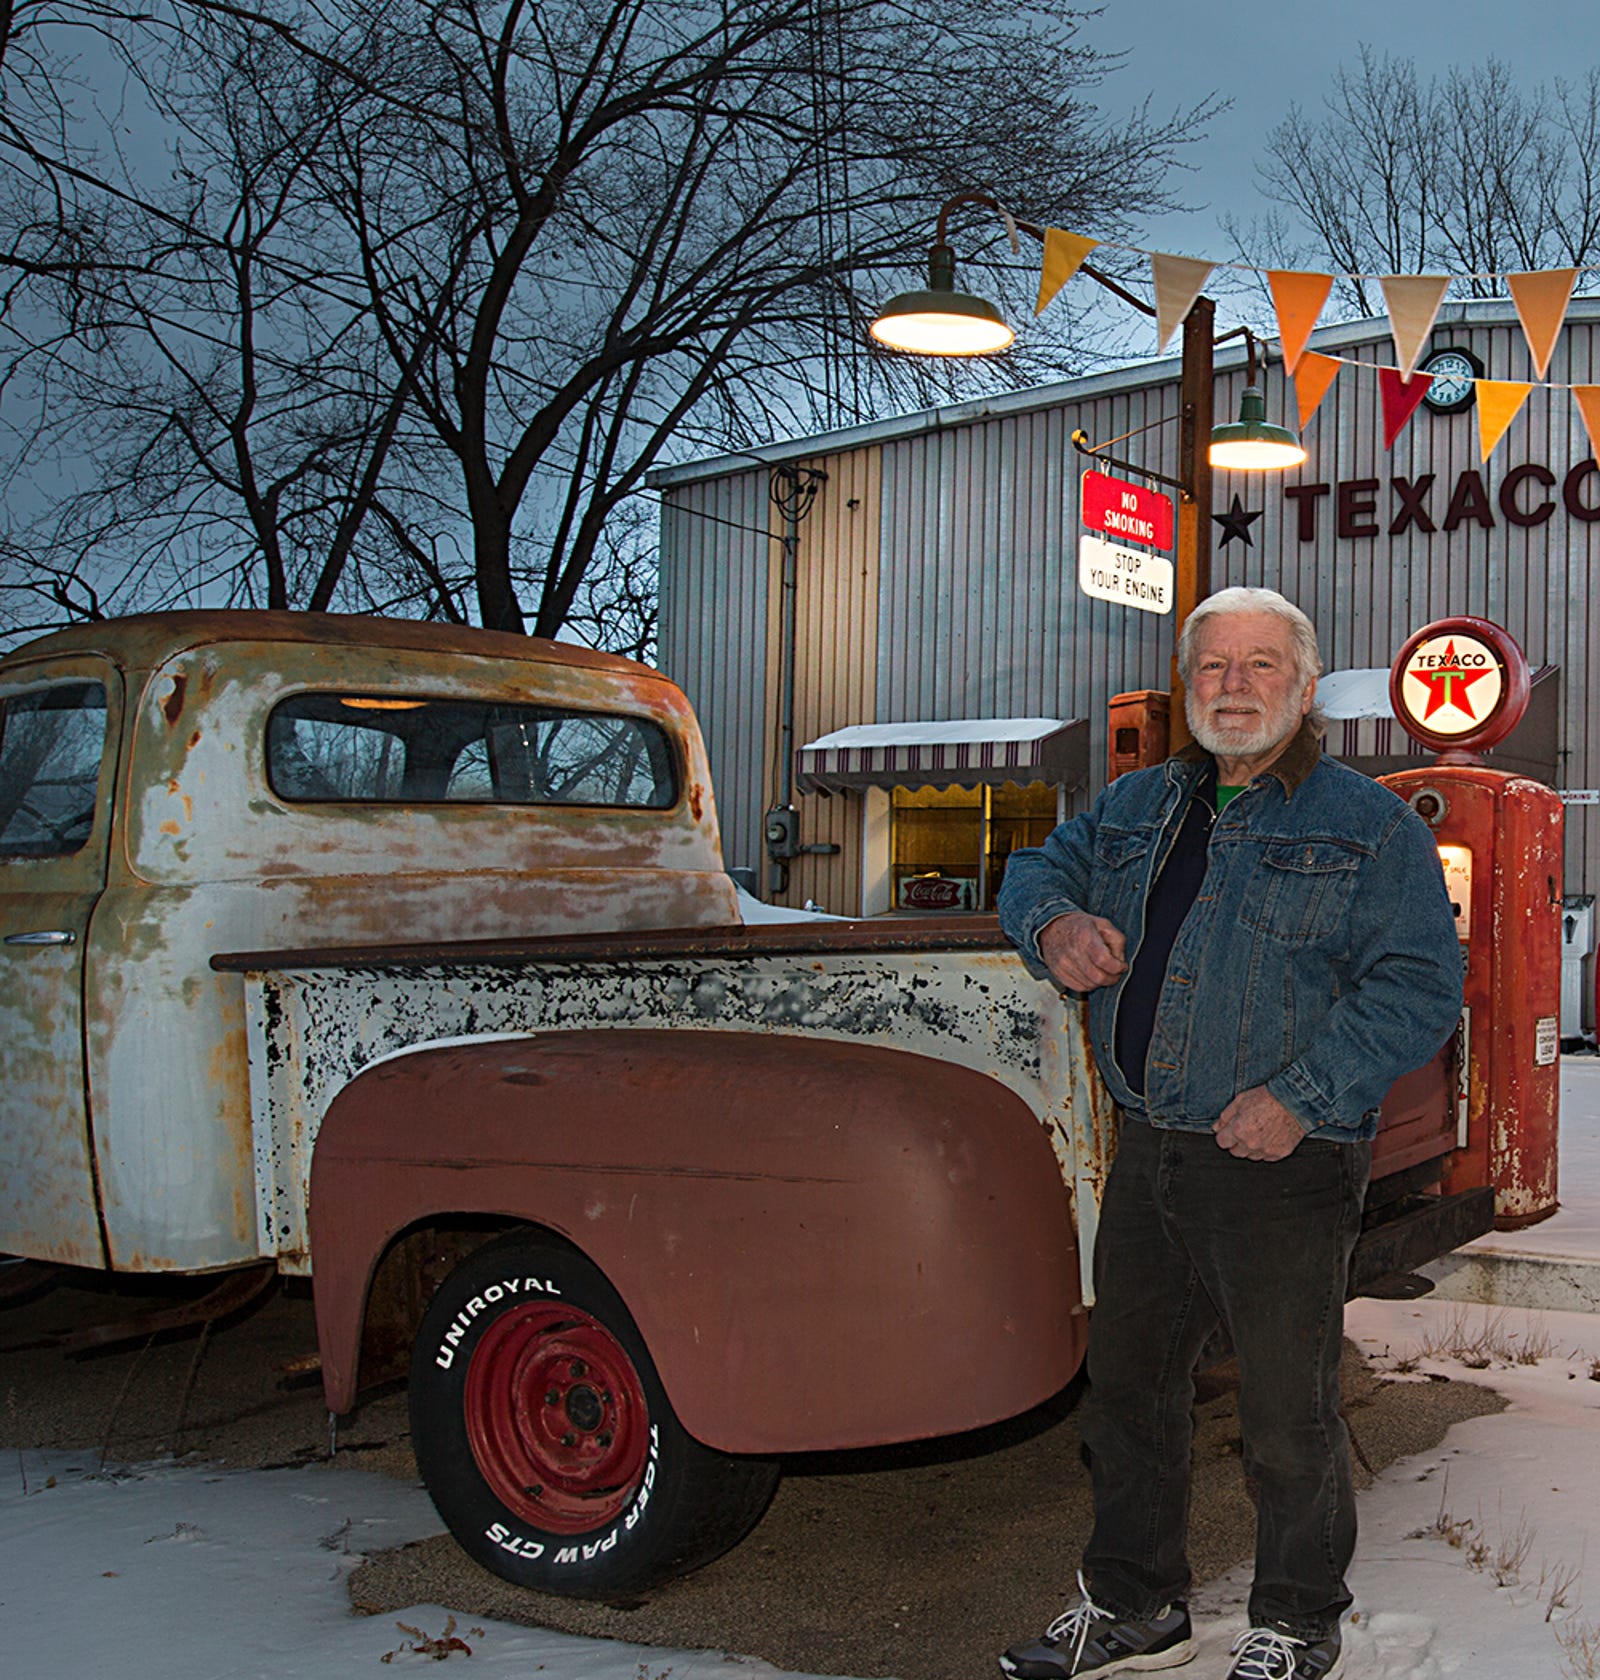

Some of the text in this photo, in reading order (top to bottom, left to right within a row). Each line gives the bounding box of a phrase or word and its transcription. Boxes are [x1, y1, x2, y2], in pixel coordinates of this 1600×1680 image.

[1122, 492, 1137, 512] NO
[1104, 509, 1153, 539] SMOKING
[1115, 553, 1141, 574] STOP
[1090, 568, 1164, 604] YOUR ENGINE
[1417, 654, 1486, 668] TEXACO
[1560, 793, 1591, 801] MOKING
[911, 883, 954, 900] Coca-Cola
[436, 1277, 562, 1369] UNIROYAL
[485, 1424, 659, 1564] TIGER PAW GTS
